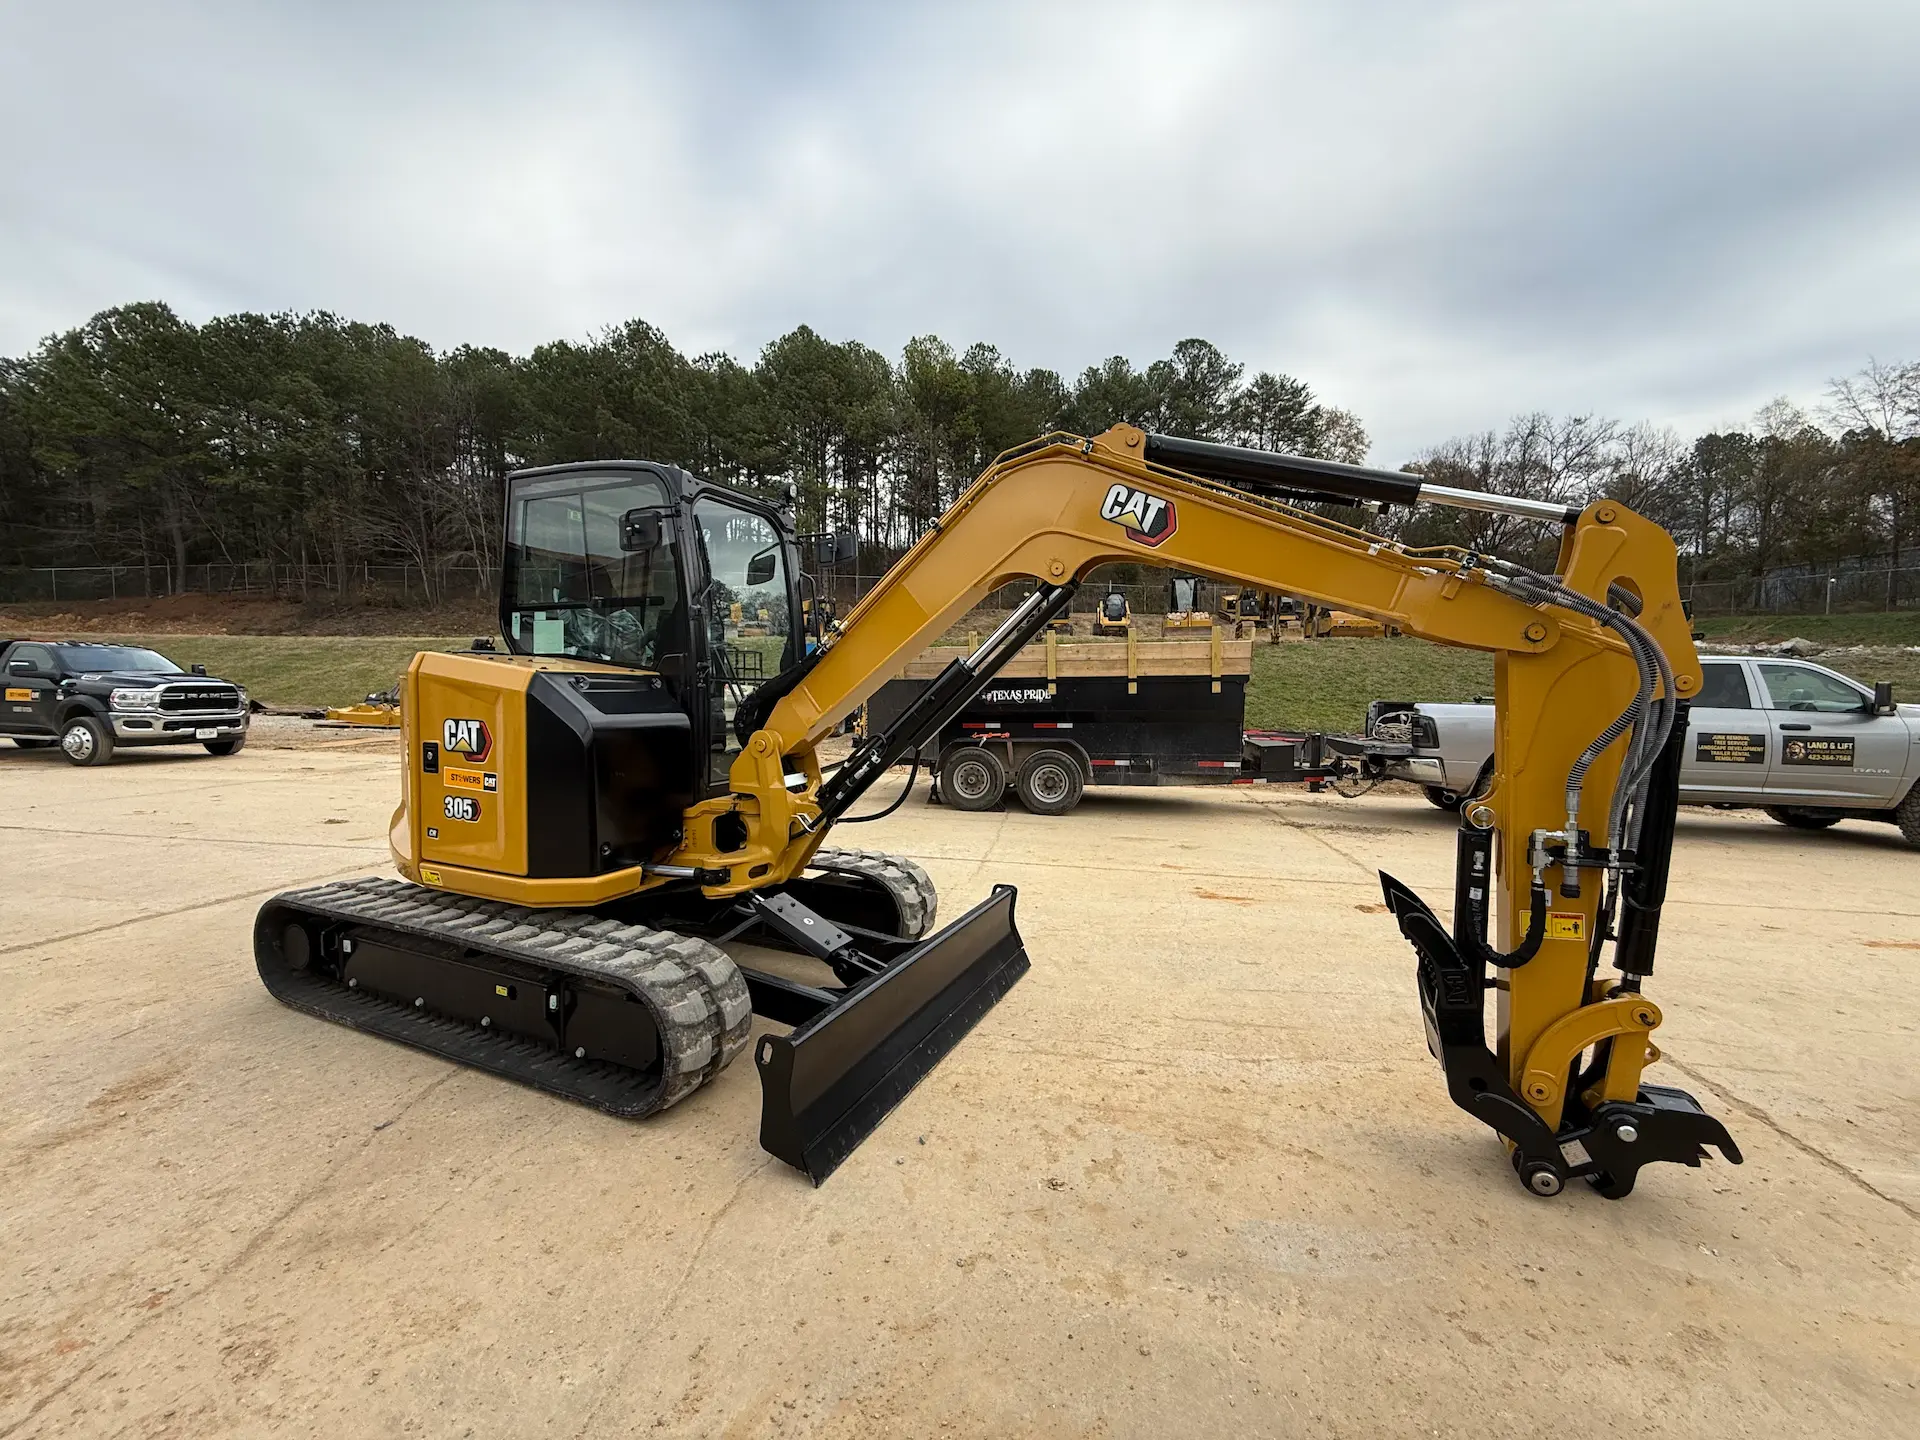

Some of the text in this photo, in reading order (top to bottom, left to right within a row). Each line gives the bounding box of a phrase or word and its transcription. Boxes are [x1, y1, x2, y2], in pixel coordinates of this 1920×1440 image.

[1101, 484, 1167, 533] CAT
[991, 689, 1052, 703] TEXAS PRIDE
[443, 719, 480, 752] CAT
[1837, 742, 1853, 750] LIFT
[450, 773, 481, 784] STOWERS
[484, 777, 496, 787] CAT
[444, 796, 472, 820] 305
